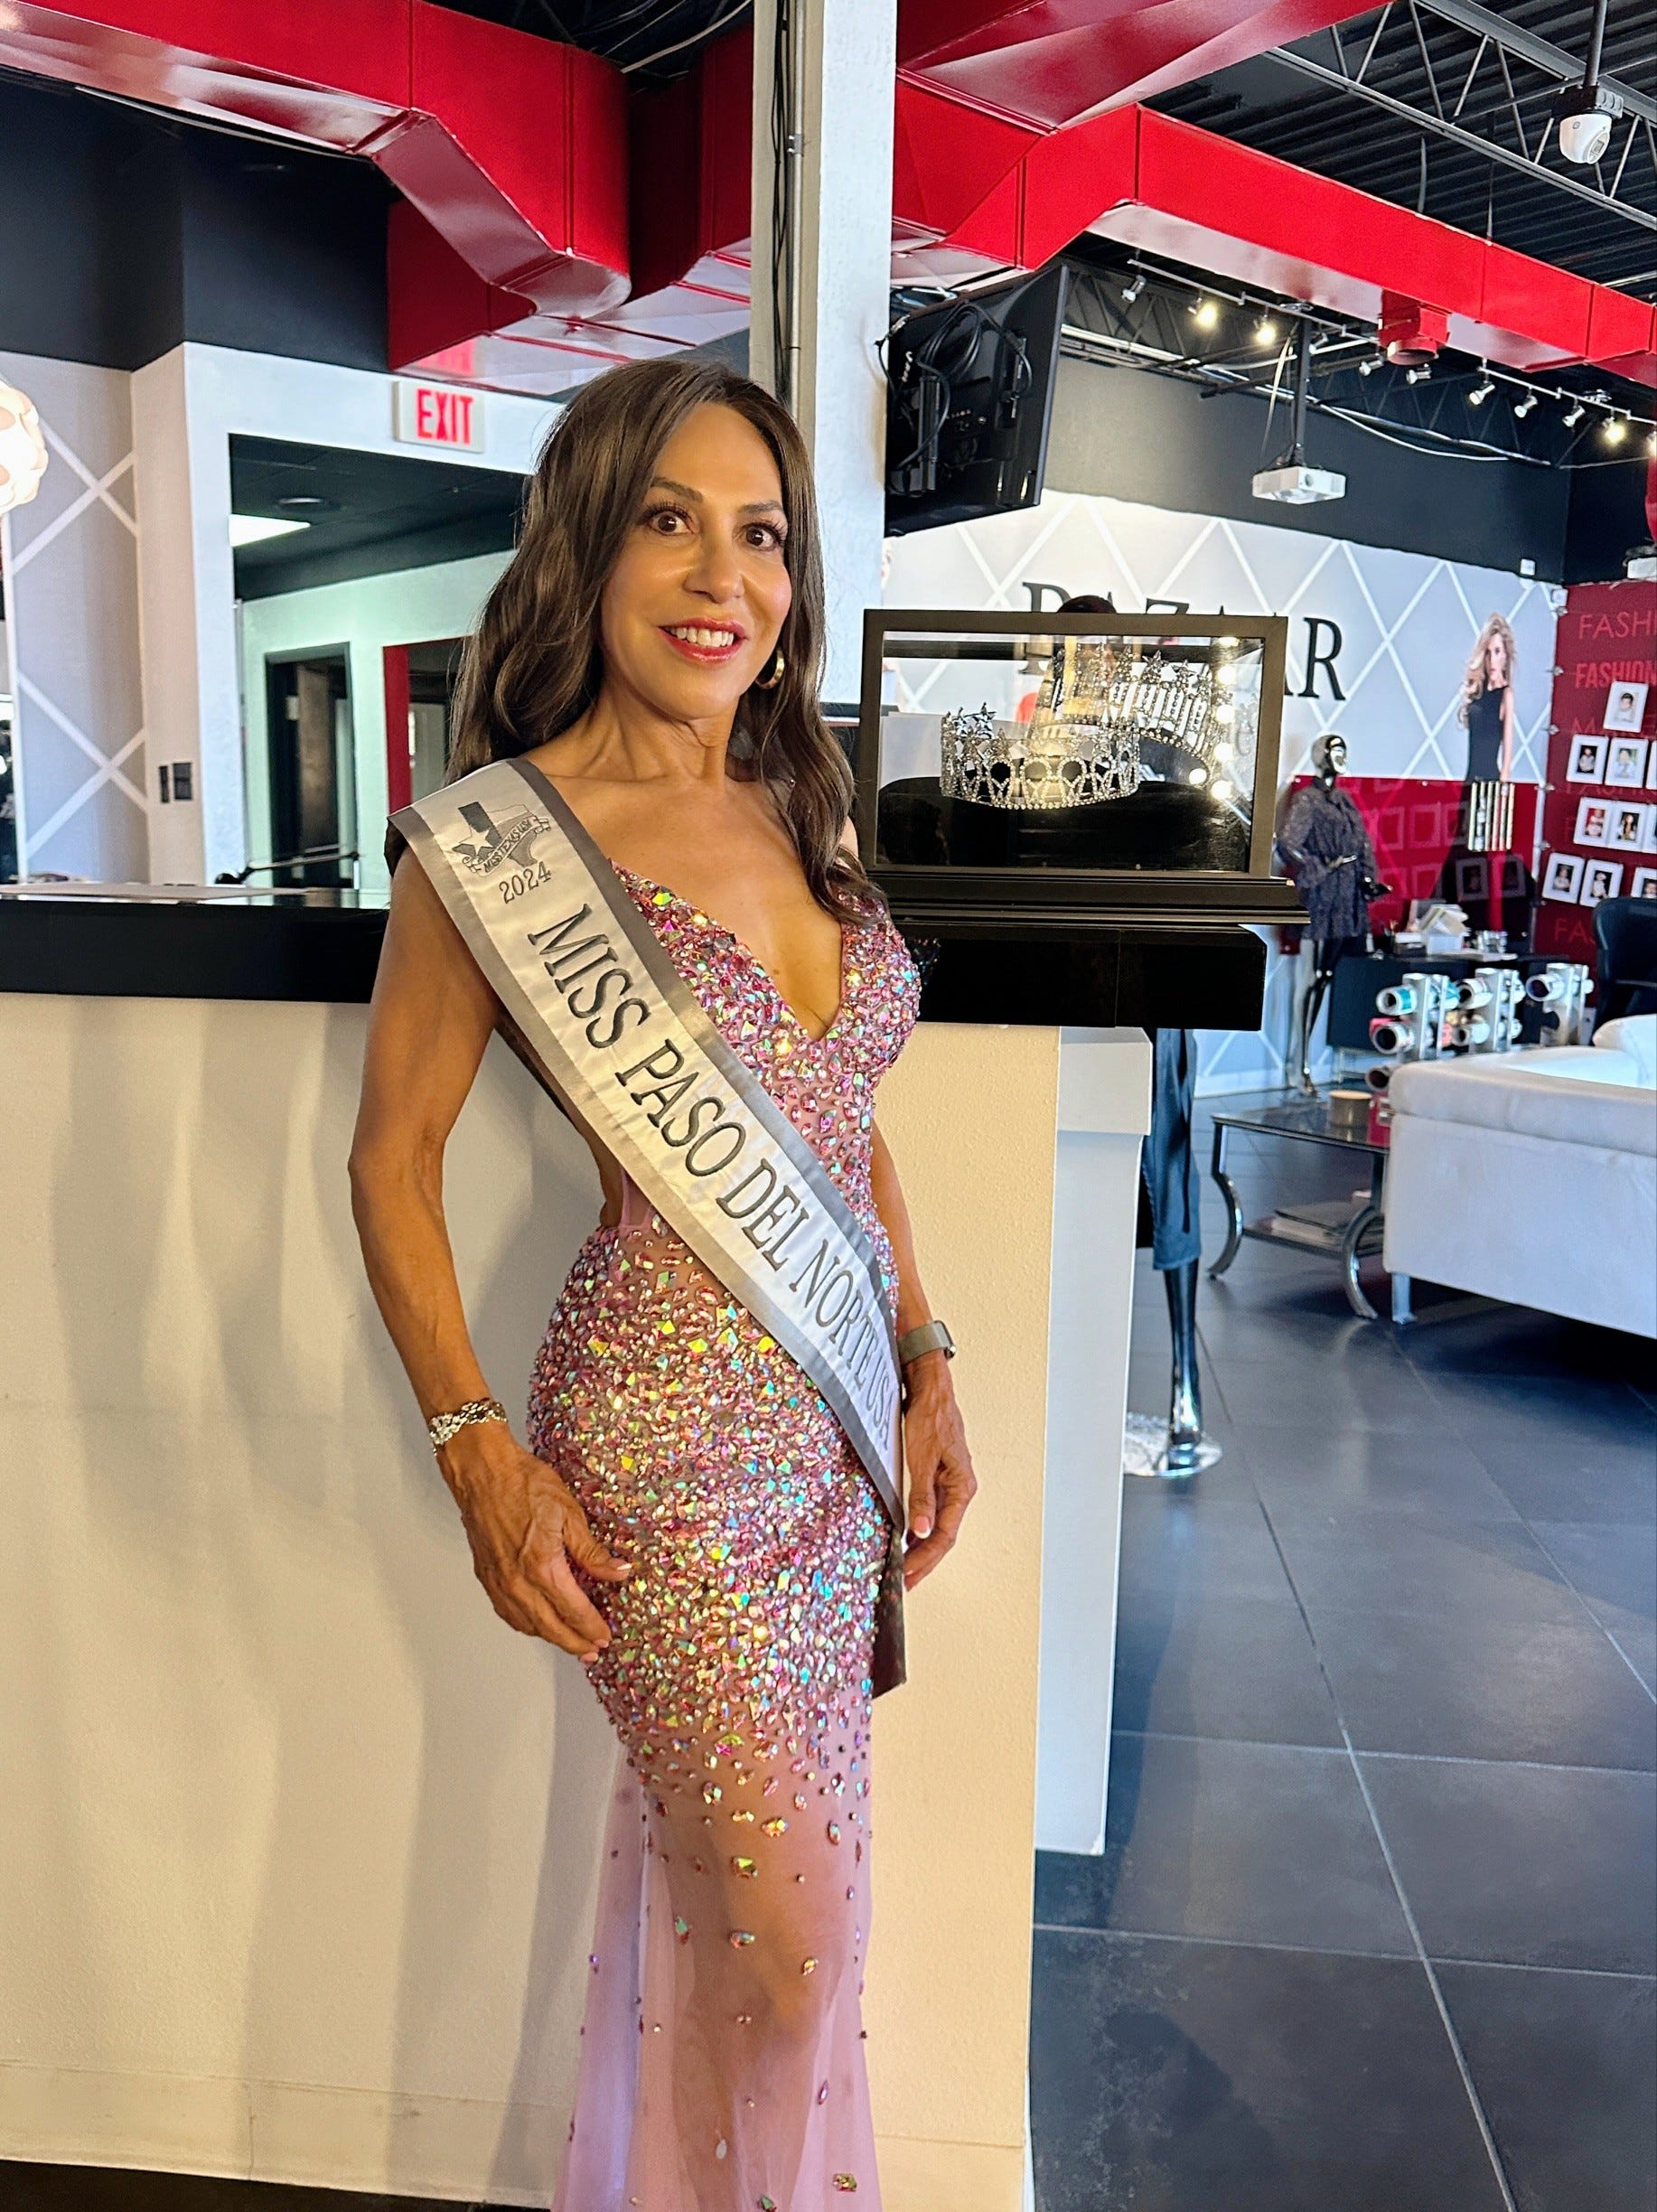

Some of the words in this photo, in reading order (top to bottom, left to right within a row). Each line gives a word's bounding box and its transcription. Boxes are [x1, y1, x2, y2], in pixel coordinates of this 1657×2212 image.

[417, 389, 474, 445] EXIT
[484, 851, 503, 873] MISS
[497, 829, 521, 856] TEXAS
[499, 861, 551, 904] 2024
[528, 904, 651, 1048] MISS
[615, 1038, 746, 1176] PASO
[716, 1158, 810, 1271] DEL
[789, 1238, 879, 1391] NORTE
[866, 1350, 894, 1450] USA
